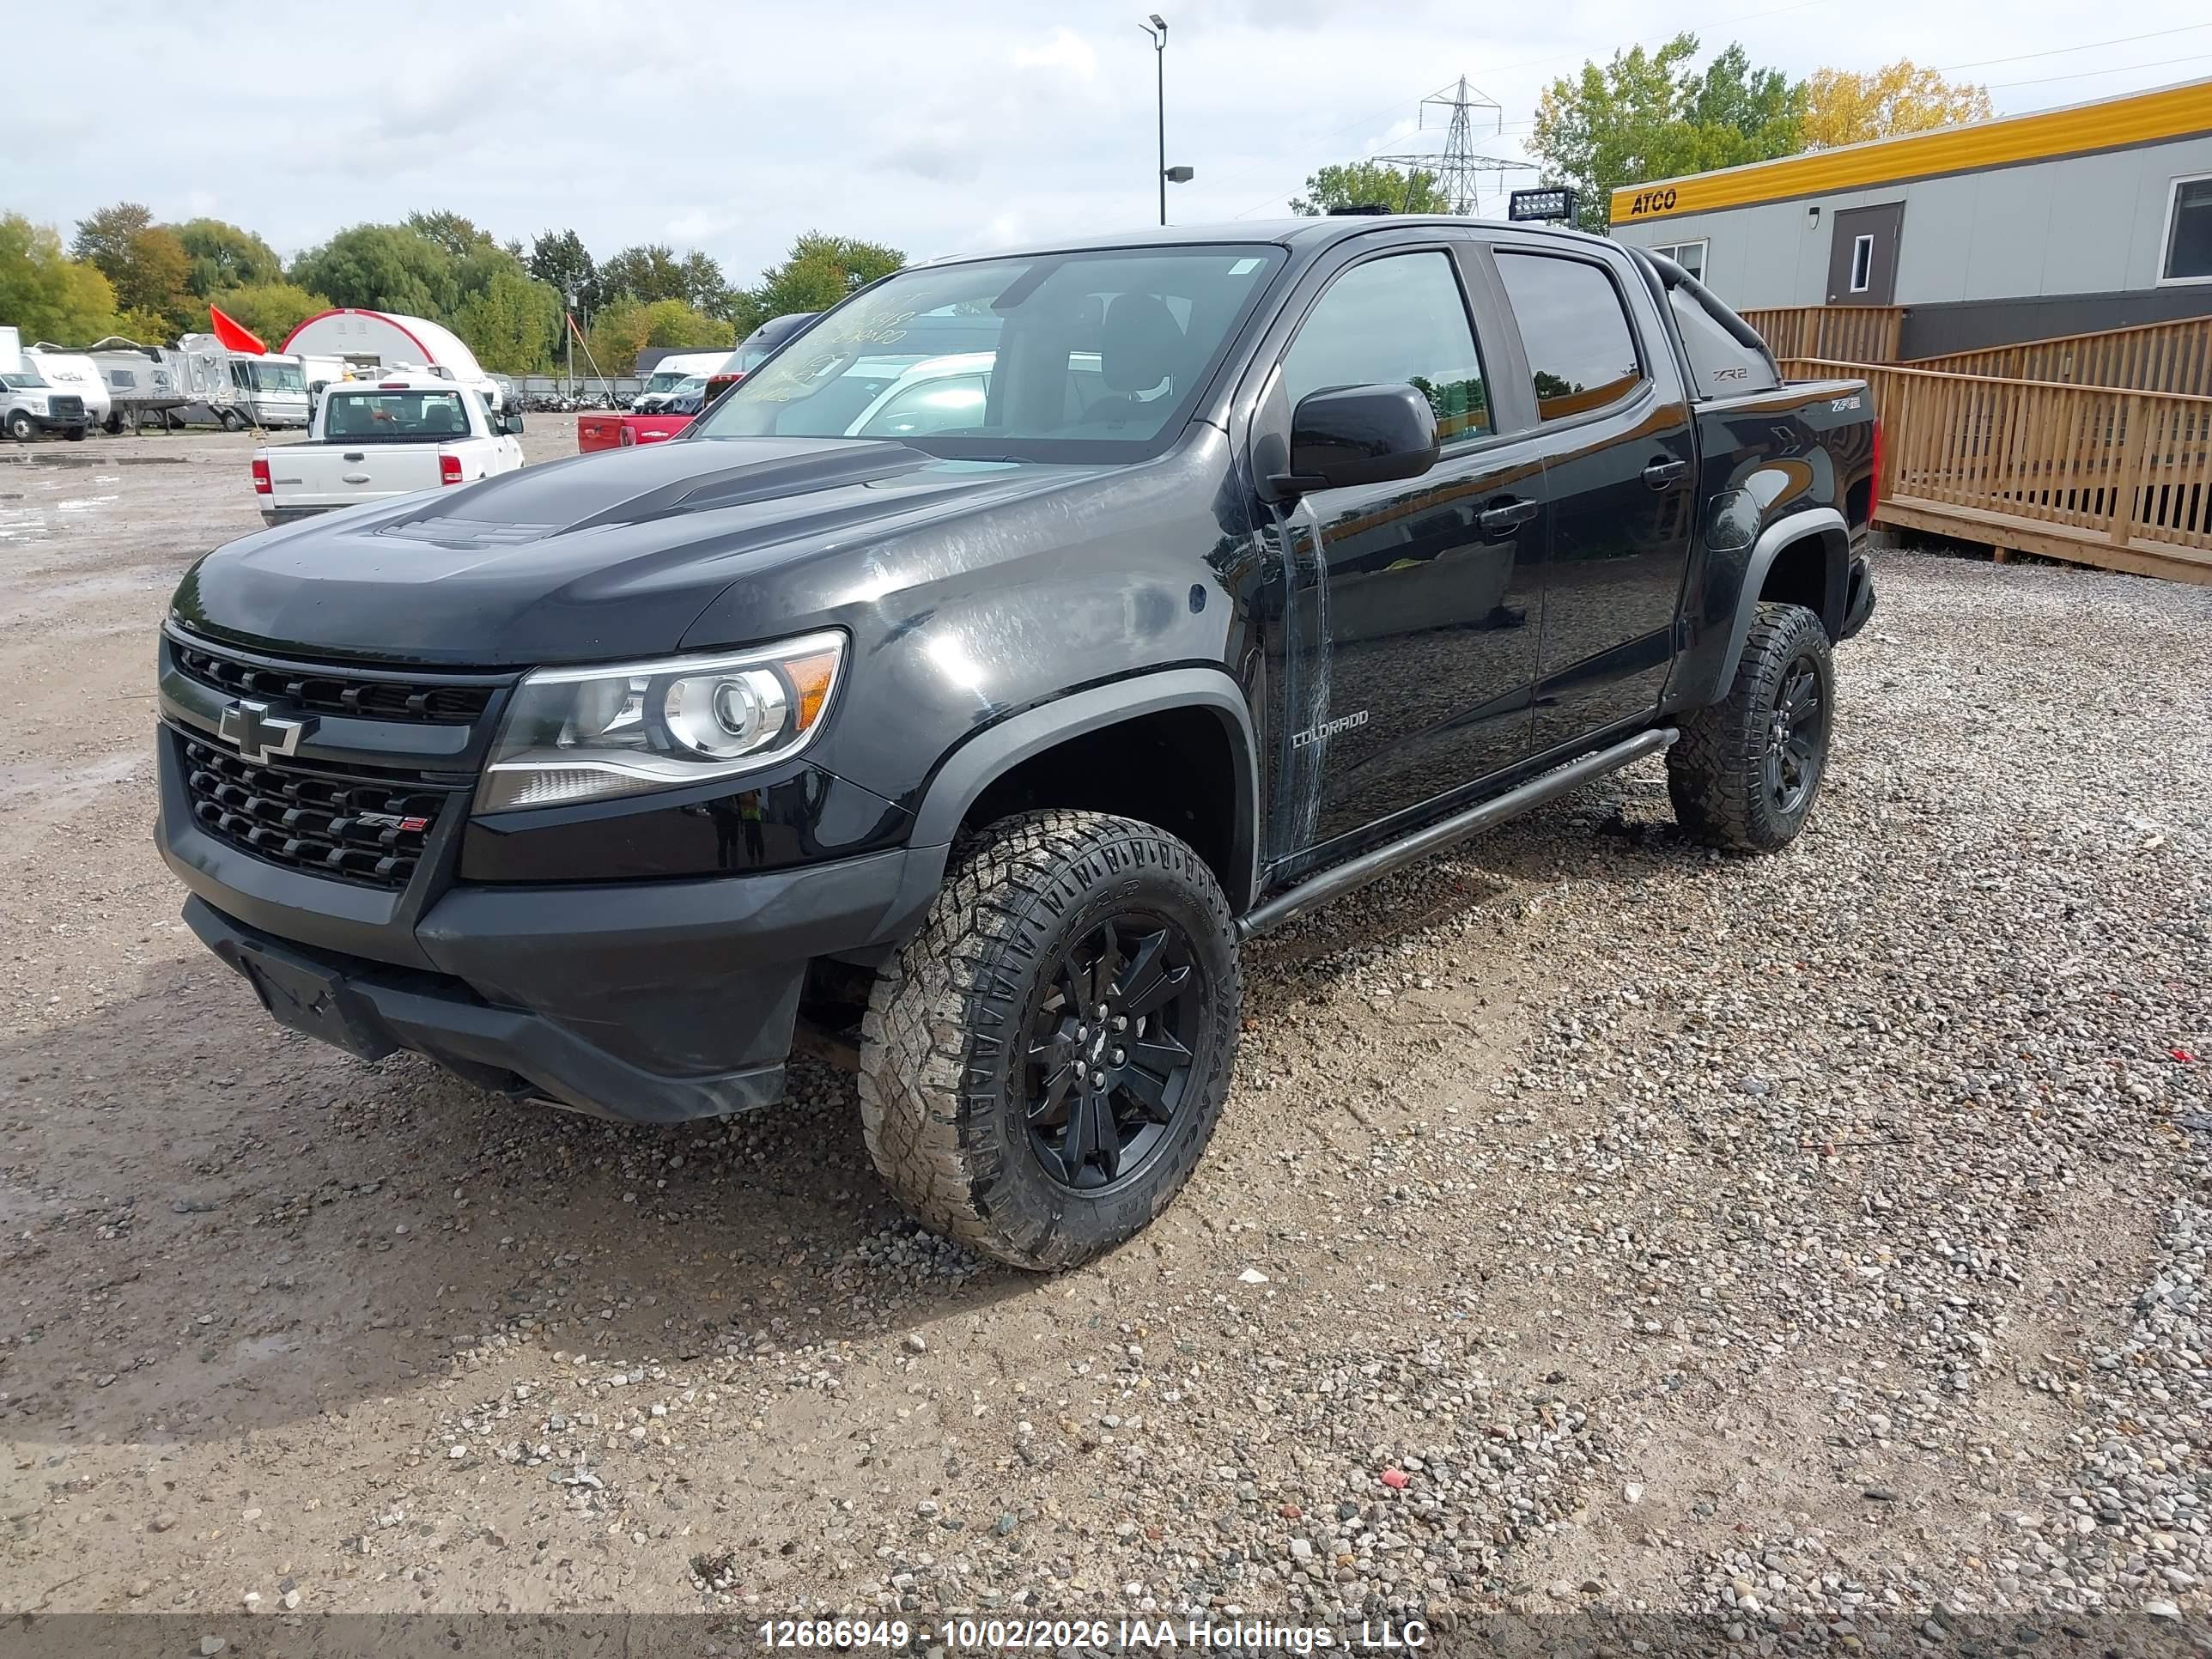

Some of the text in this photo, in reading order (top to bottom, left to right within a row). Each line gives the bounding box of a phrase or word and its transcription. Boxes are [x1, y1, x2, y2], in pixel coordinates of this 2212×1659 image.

[1631, 188, 1677, 215] ATCO
[1713, 368, 1748, 382] ZR2
[1832, 397, 1862, 412] ZR2
[1291, 709, 1370, 750] COLORADO
[356, 811, 428, 832] ZR2
